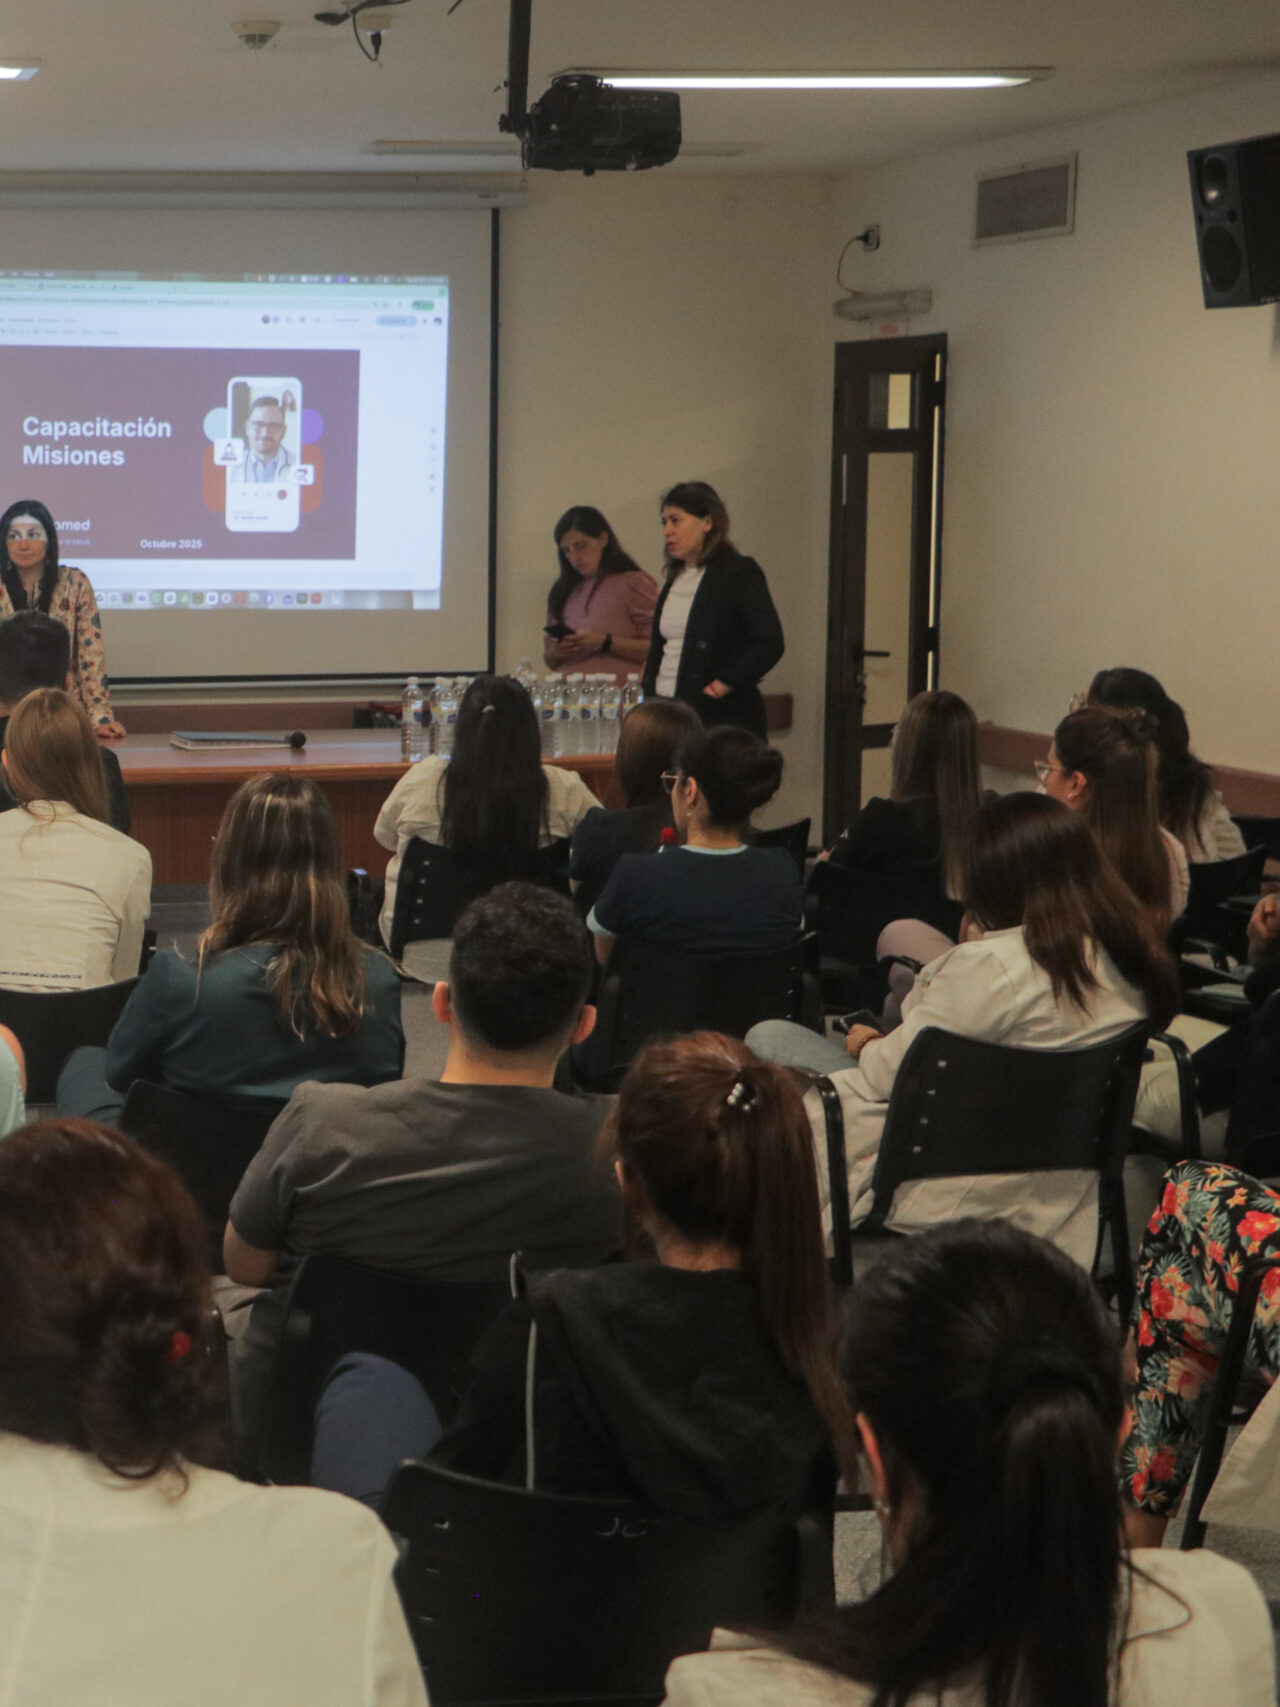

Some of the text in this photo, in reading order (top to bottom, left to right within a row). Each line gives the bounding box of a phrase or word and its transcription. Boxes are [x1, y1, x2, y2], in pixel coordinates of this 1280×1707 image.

[23, 416, 172, 441] Capacitación
[23, 444, 125, 466] Misiones
[54, 518, 91, 531] amed
[140, 539, 202, 549] Octubre 2025
